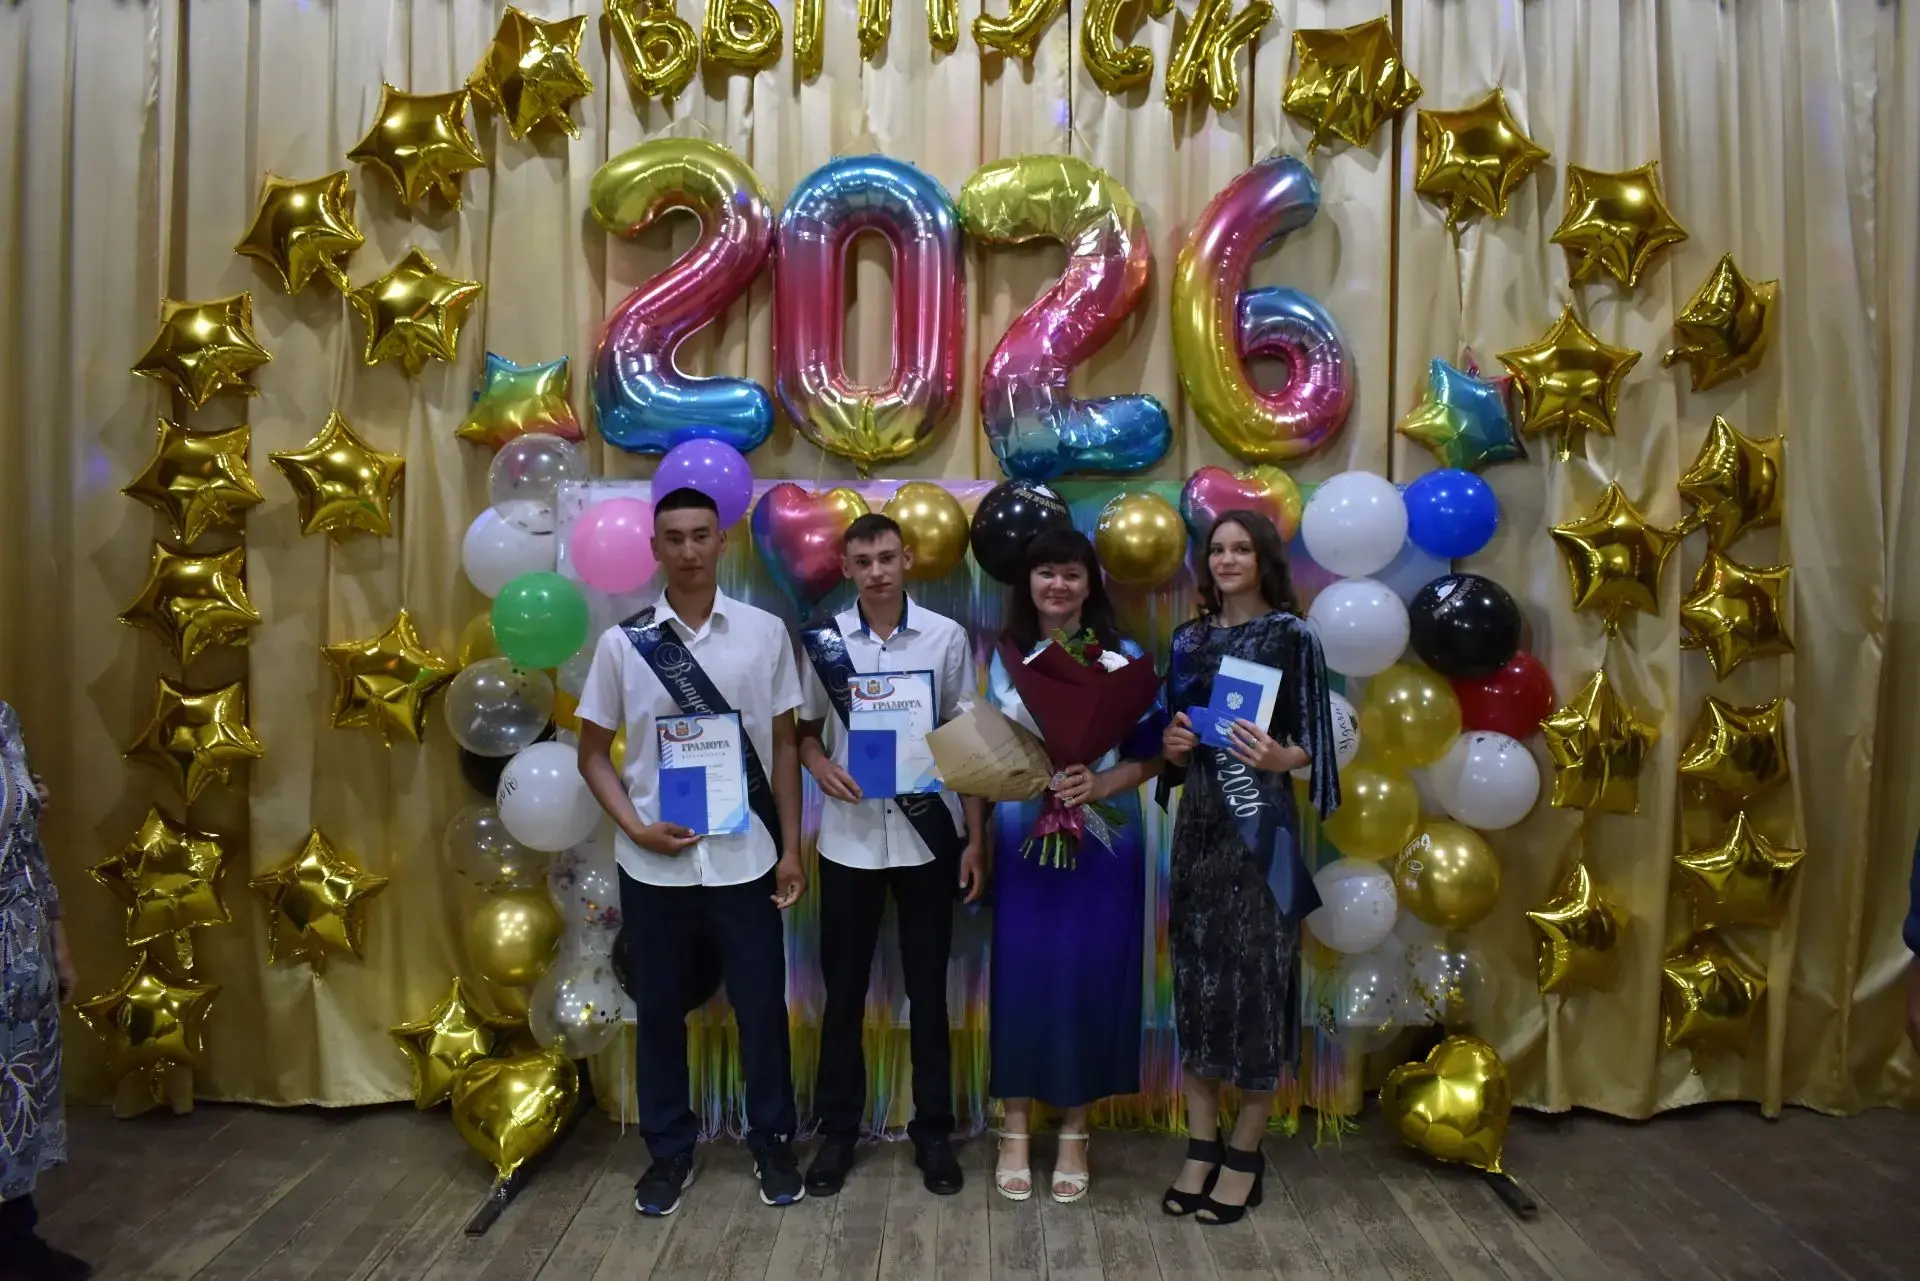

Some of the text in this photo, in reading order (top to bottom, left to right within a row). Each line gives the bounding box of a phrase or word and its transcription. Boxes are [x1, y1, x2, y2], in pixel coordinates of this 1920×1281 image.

[589, 137, 1354, 478] 2026
[872, 699, 923, 711] ГРАМОТА
[681, 739, 731, 753] ГРАМОТА
[1216, 763, 1272, 818] 2026
